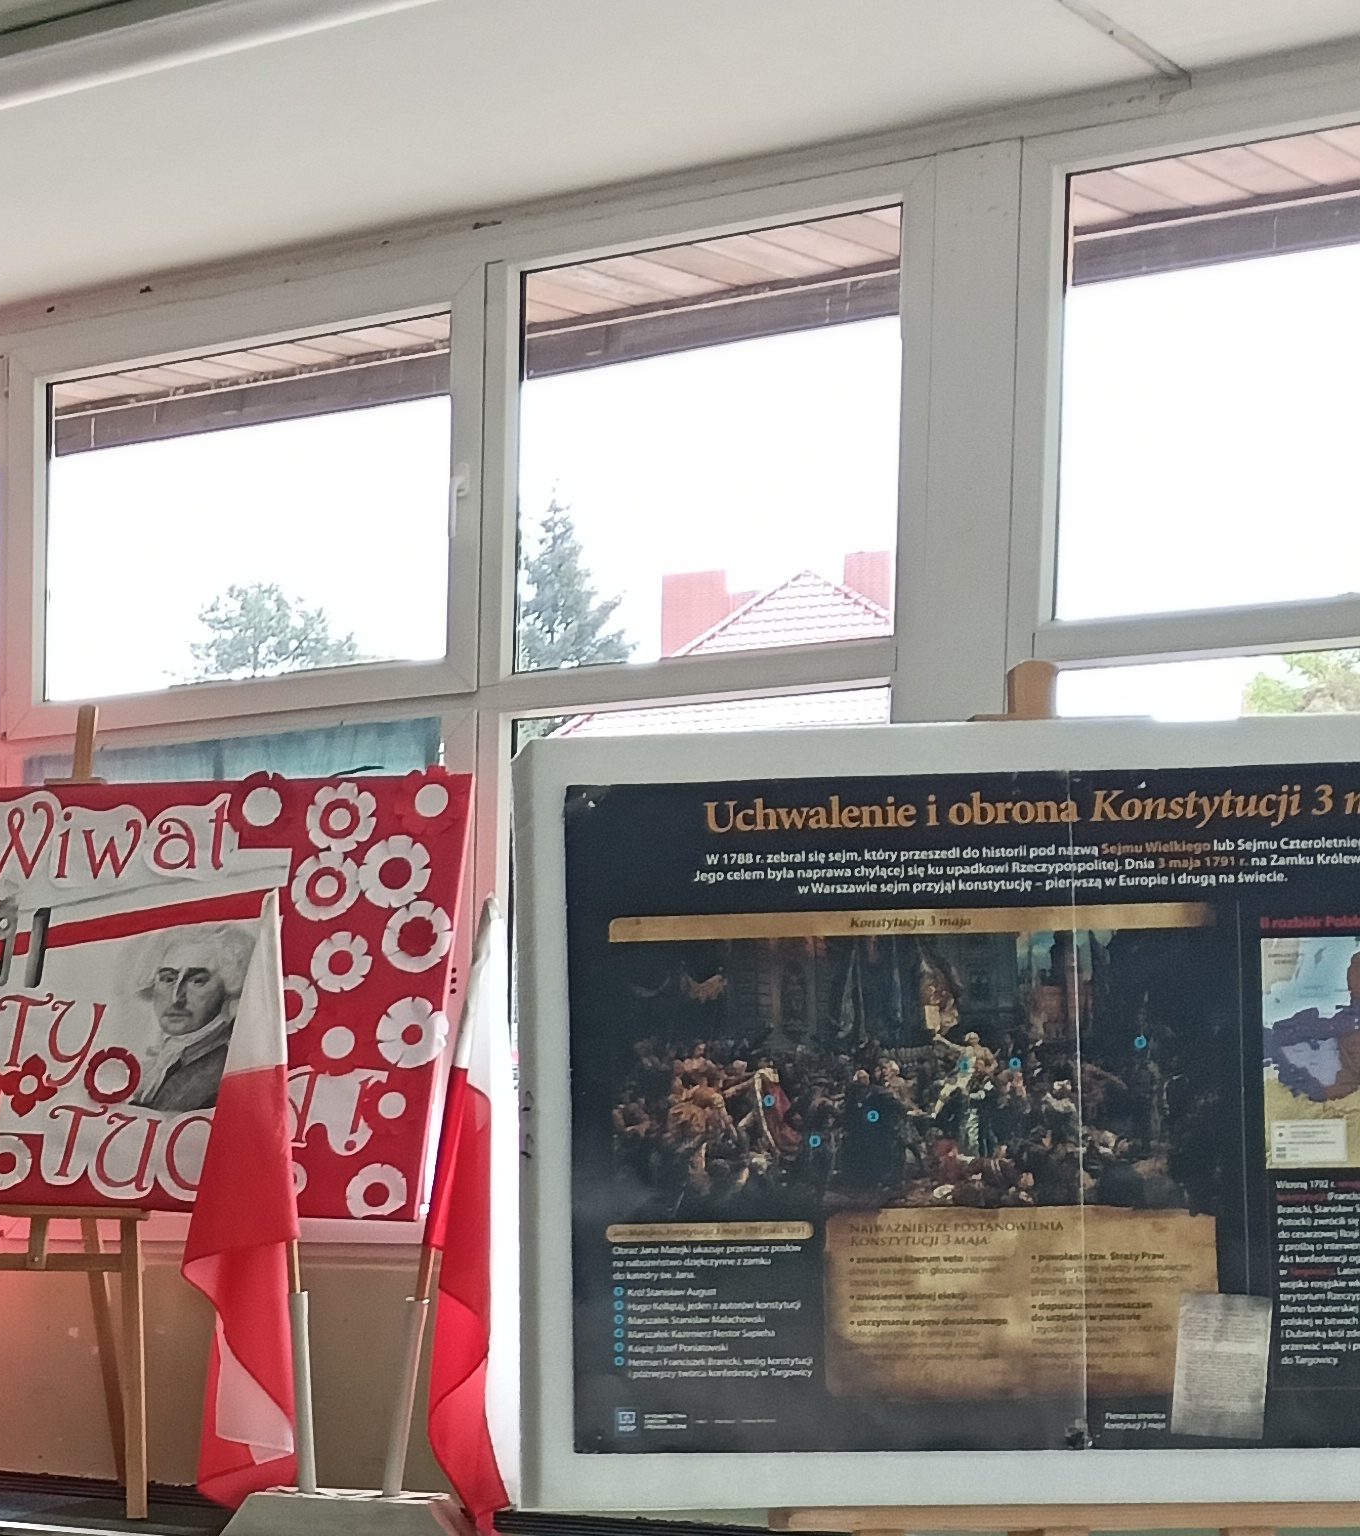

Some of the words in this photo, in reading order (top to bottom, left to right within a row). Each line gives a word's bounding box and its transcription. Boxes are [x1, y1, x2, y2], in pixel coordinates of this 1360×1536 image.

[704, 795, 917, 833] Uchwalenie
[927, 794, 940, 826] i
[948, 791, 1080, 825] obrona
[1090, 784, 1302, 828] Konstytucji
[1311, 784, 1334, 815] 3
[706, 854, 719, 865] W
[722, 853, 753, 865] 1788
[756, 855, 765, 864] r.
[766, 851, 806, 864] zebrał
[808, 851, 825, 865] się
[828, 851, 862, 864] sejm,
[864, 849, 897, 864] który
[900, 847, 960, 863] przeszedł
[962, 847, 980, 859] do
[982, 845, 1027, 858] historii
[1030, 844, 1055, 859] pod
[1058, 844, 1099, 858] nazwą
[1102, 842, 1143, 857] Sejmu
[1145, 840, 1211, 855] Wielkiego
[1213, 839, 1235, 851] lub
[1237, 838, 1278, 853] Sejmu
[1280, 836, 1360, 849] Czteroletnie
[694, 870, 724, 884] Jego
[726, 869, 764, 881] celem
[767, 867, 794, 882] była
[797, 868, 852, 882] naprawa
[854, 864, 905, 881] chylącej
[907, 864, 925, 878] się
[928, 864, 944, 876] ku
[946, 862, 1009, 877] upadkowi
[1125, 857, 1155, 870] Dnia
[1158, 857, 1166, 869] 3
[1168, 856, 1202, 870] maja
[1204, 855, 1236, 868] 1791
[1251, 856, 1267, 866] na
[1269, 853, 1314, 866] Zamku
[797, 886, 809, 895] w
[811, 881, 878, 895] Warszawie
[880, 881, 910, 895] sejm
[913, 879, 956, 894] przyjął
[958, 877, 1032, 893] konstytucję
[1045, 875, 1102, 890] pierwszą
[1104, 876, 1117, 887] w
[1119, 873, 1168, 888] Europie
[1178, 872, 1216, 887] drugą
[1219, 873, 1235, 883] na
[1237, 870, 1289, 883] świecie.
[850, 915, 926, 932] Konstytucja
[930, 915, 938, 928] 3
[940, 916, 972, 930] maja
